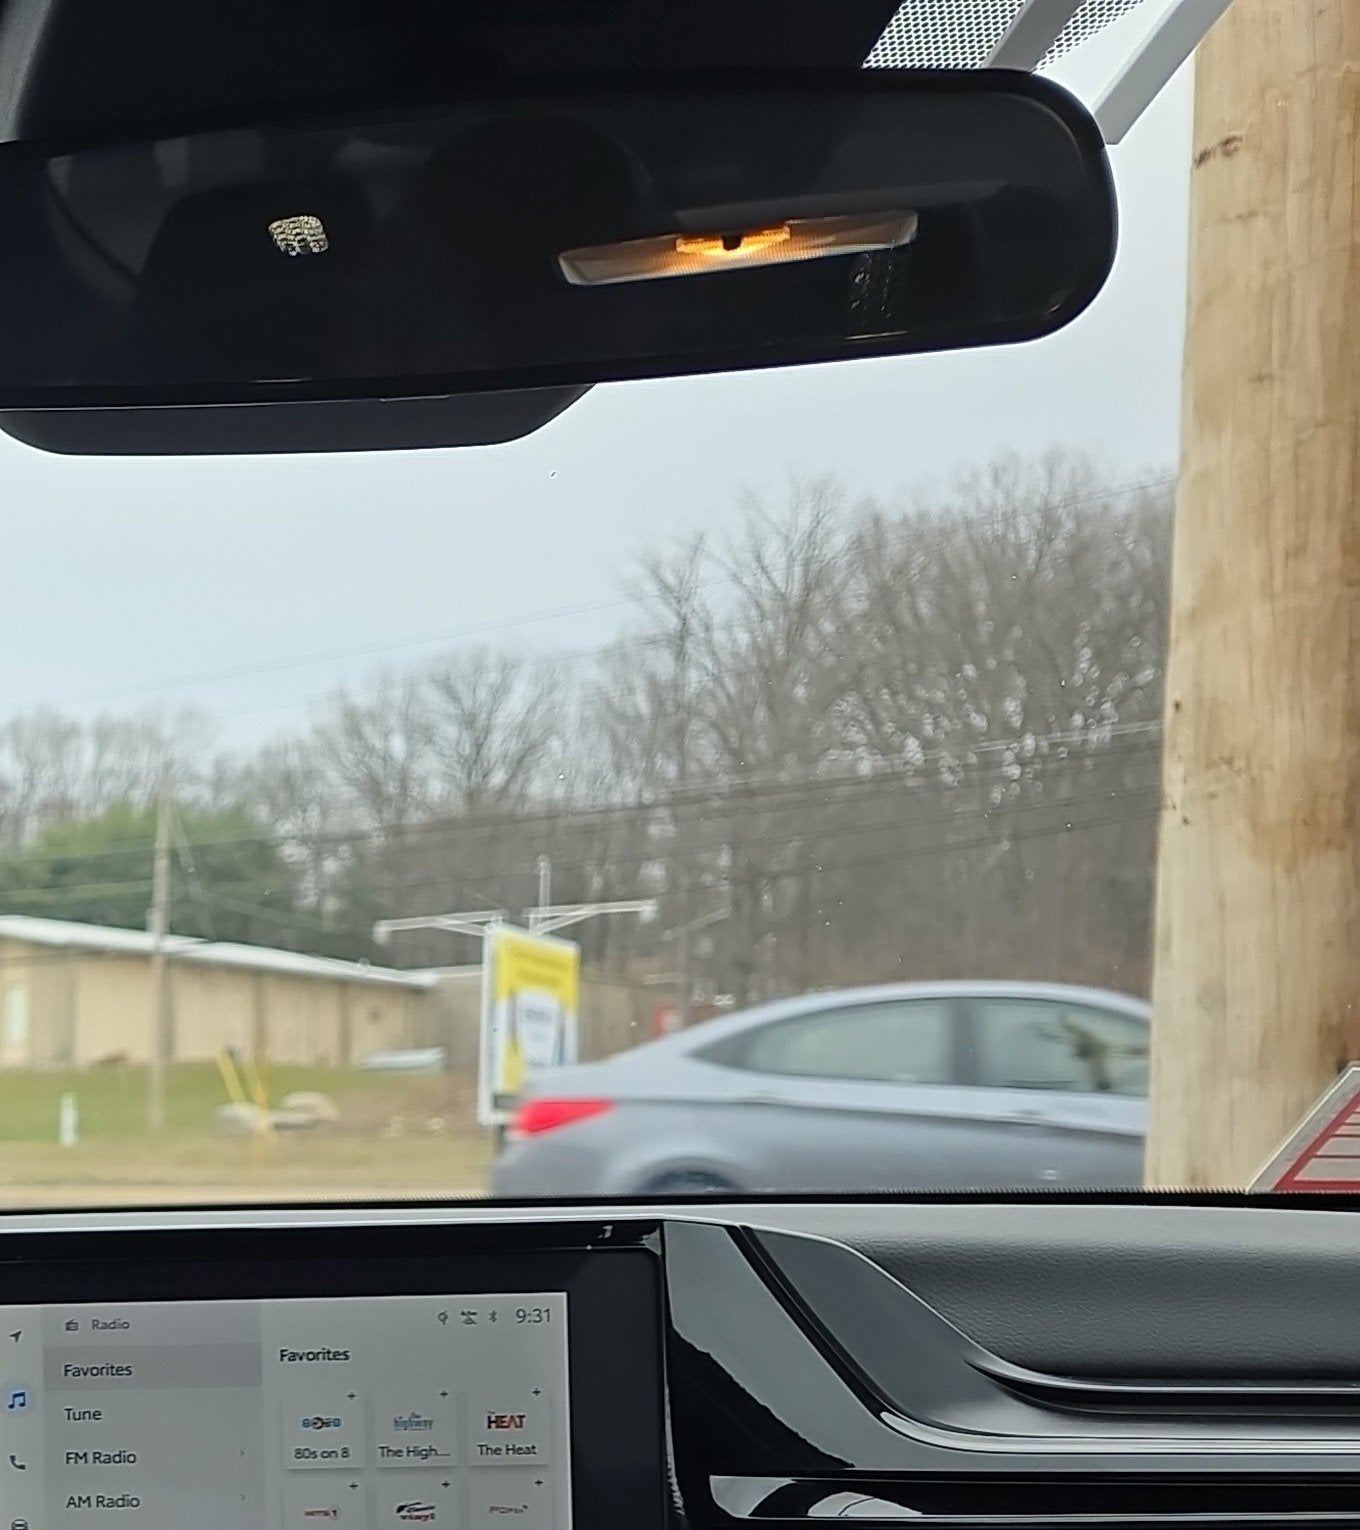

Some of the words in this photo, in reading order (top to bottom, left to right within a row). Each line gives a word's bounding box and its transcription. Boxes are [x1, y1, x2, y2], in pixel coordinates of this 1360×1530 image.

[516, 1308, 551, 1323] 9:31
[91, 1318, 130, 1331] Radio
[279, 1347, 351, 1363] Favorites
[63, 1363, 132, 1378] Favorites
[64, 1407, 103, 1421] Tune
[486, 1415, 526, 1429] HEAT
[378, 1445, 404, 1458] The
[477, 1443, 503, 1456] The
[505, 1443, 537, 1456] Heat
[65, 1451, 88, 1465] FM
[91, 1450, 137, 1465] Radio
[66, 1495, 92, 1508] AM
[95, 1494, 140, 1508] Radio
